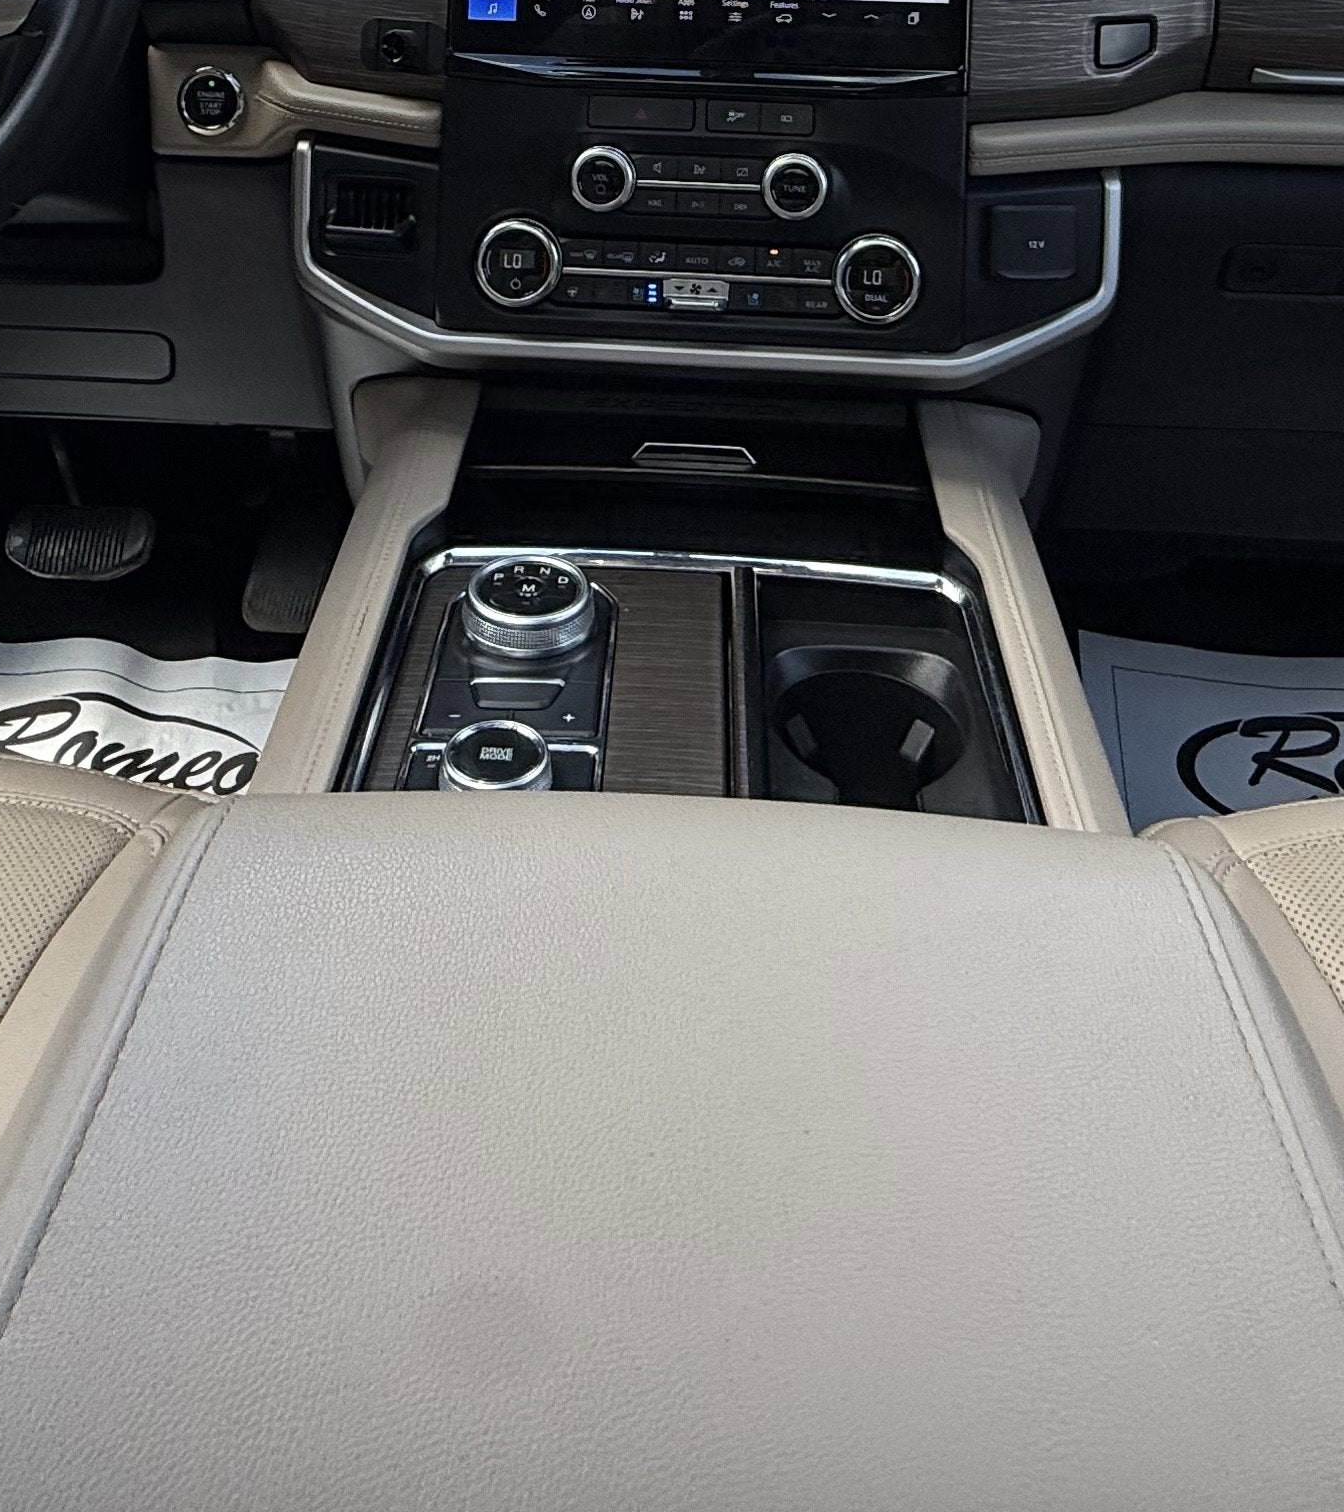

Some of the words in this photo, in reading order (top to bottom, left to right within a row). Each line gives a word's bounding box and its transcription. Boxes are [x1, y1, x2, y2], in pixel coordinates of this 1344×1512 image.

[721, 0, 750, 9] Settings
[769, 1, 800, 9] Features
[592, 173, 609, 183] VOL
[783, 184, 808, 194] TUNE
[685, 256, 709, 265] AUTO
[864, 294, 888, 303] DUAL
[804, 300, 828, 309] REAR
[513, 565, 525, 574] R
[539, 566, 551, 576] N
[492, 573, 505, 582] P
[557, 575, 570, 585] D
[521, 583, 537, 593] M
[481, 747, 514, 755] DRIVE
[479, 753, 513, 761] MODE
